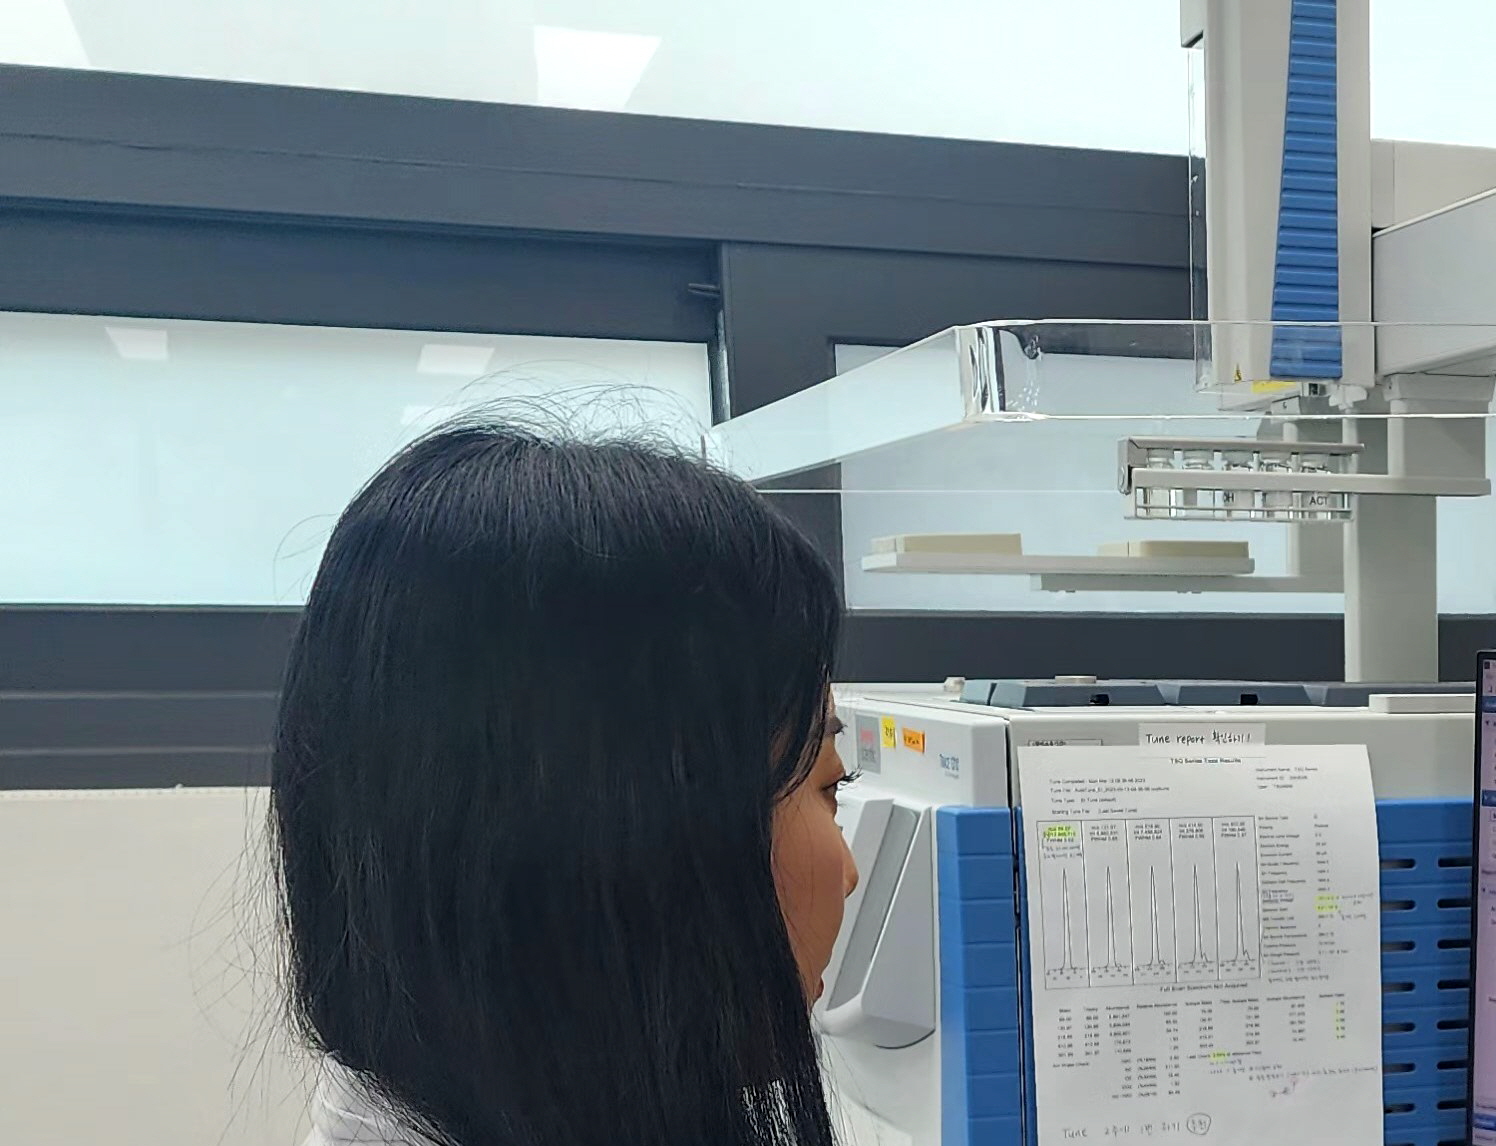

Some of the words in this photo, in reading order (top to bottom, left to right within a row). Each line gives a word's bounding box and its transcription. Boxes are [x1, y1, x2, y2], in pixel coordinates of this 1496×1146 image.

[1309, 496, 1328, 505] ACT
[1145, 733, 1171, 744] Tune
[1176, 735, 1205, 747] report
[1062, 1127, 1088, 1139] Tune
